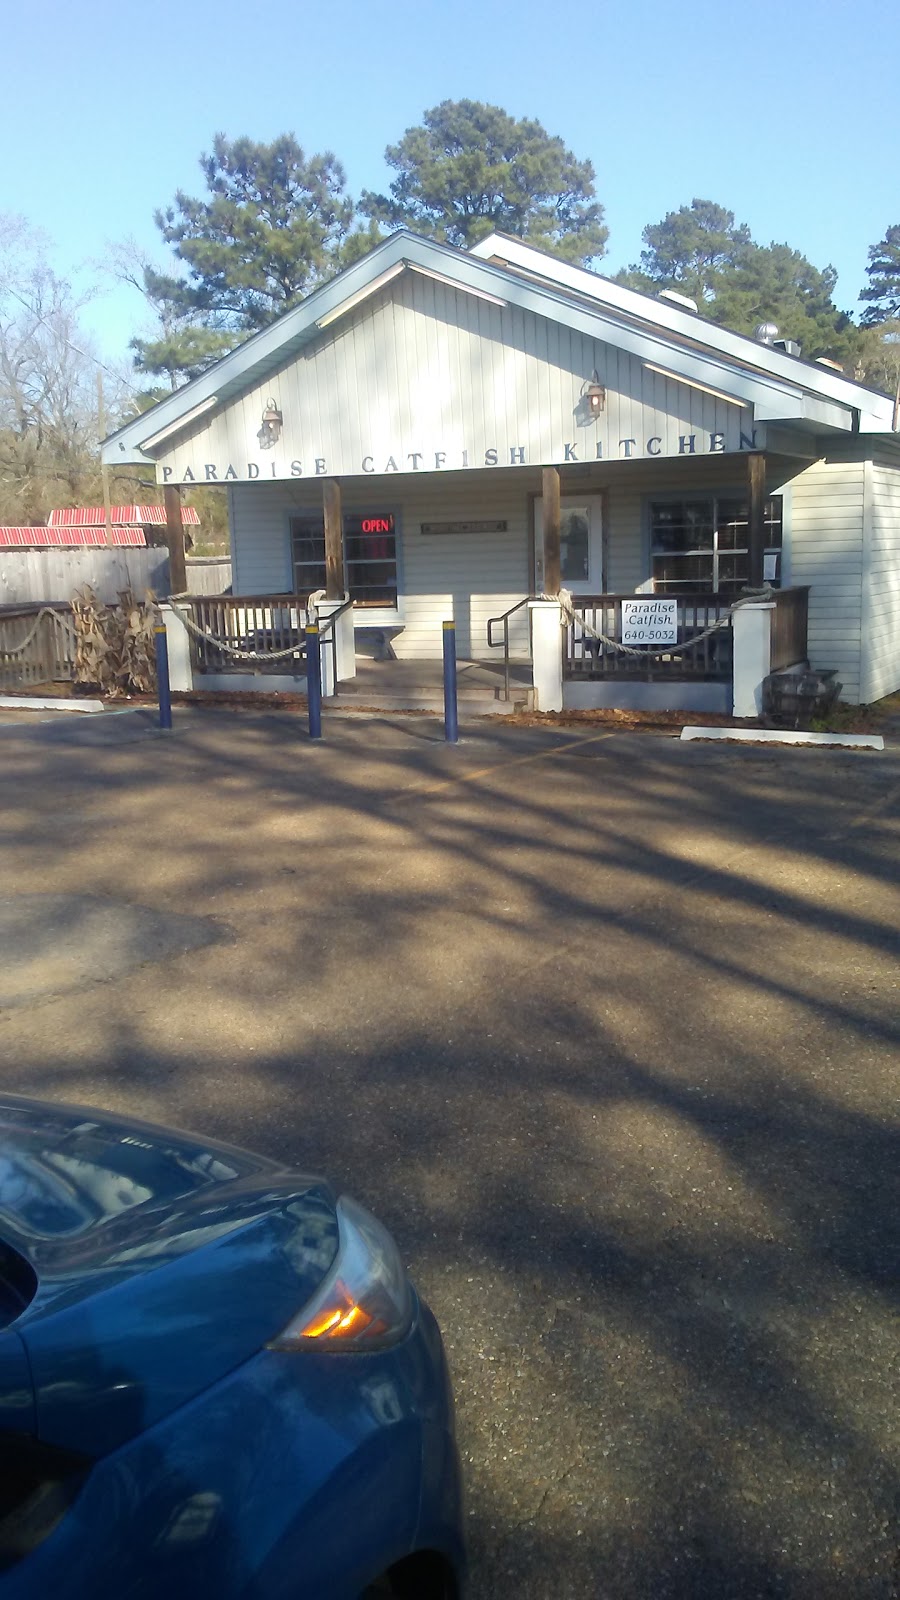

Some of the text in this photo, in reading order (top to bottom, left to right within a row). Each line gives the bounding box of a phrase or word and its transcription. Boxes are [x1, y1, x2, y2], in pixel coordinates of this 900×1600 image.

[162, 430, 757, 482] PARADISE CATFISH KITCHEN
[361, 519, 389, 533] OPEN
[624, 603, 675, 613] Paradise
[624, 630, 675, 640] 640-5032
